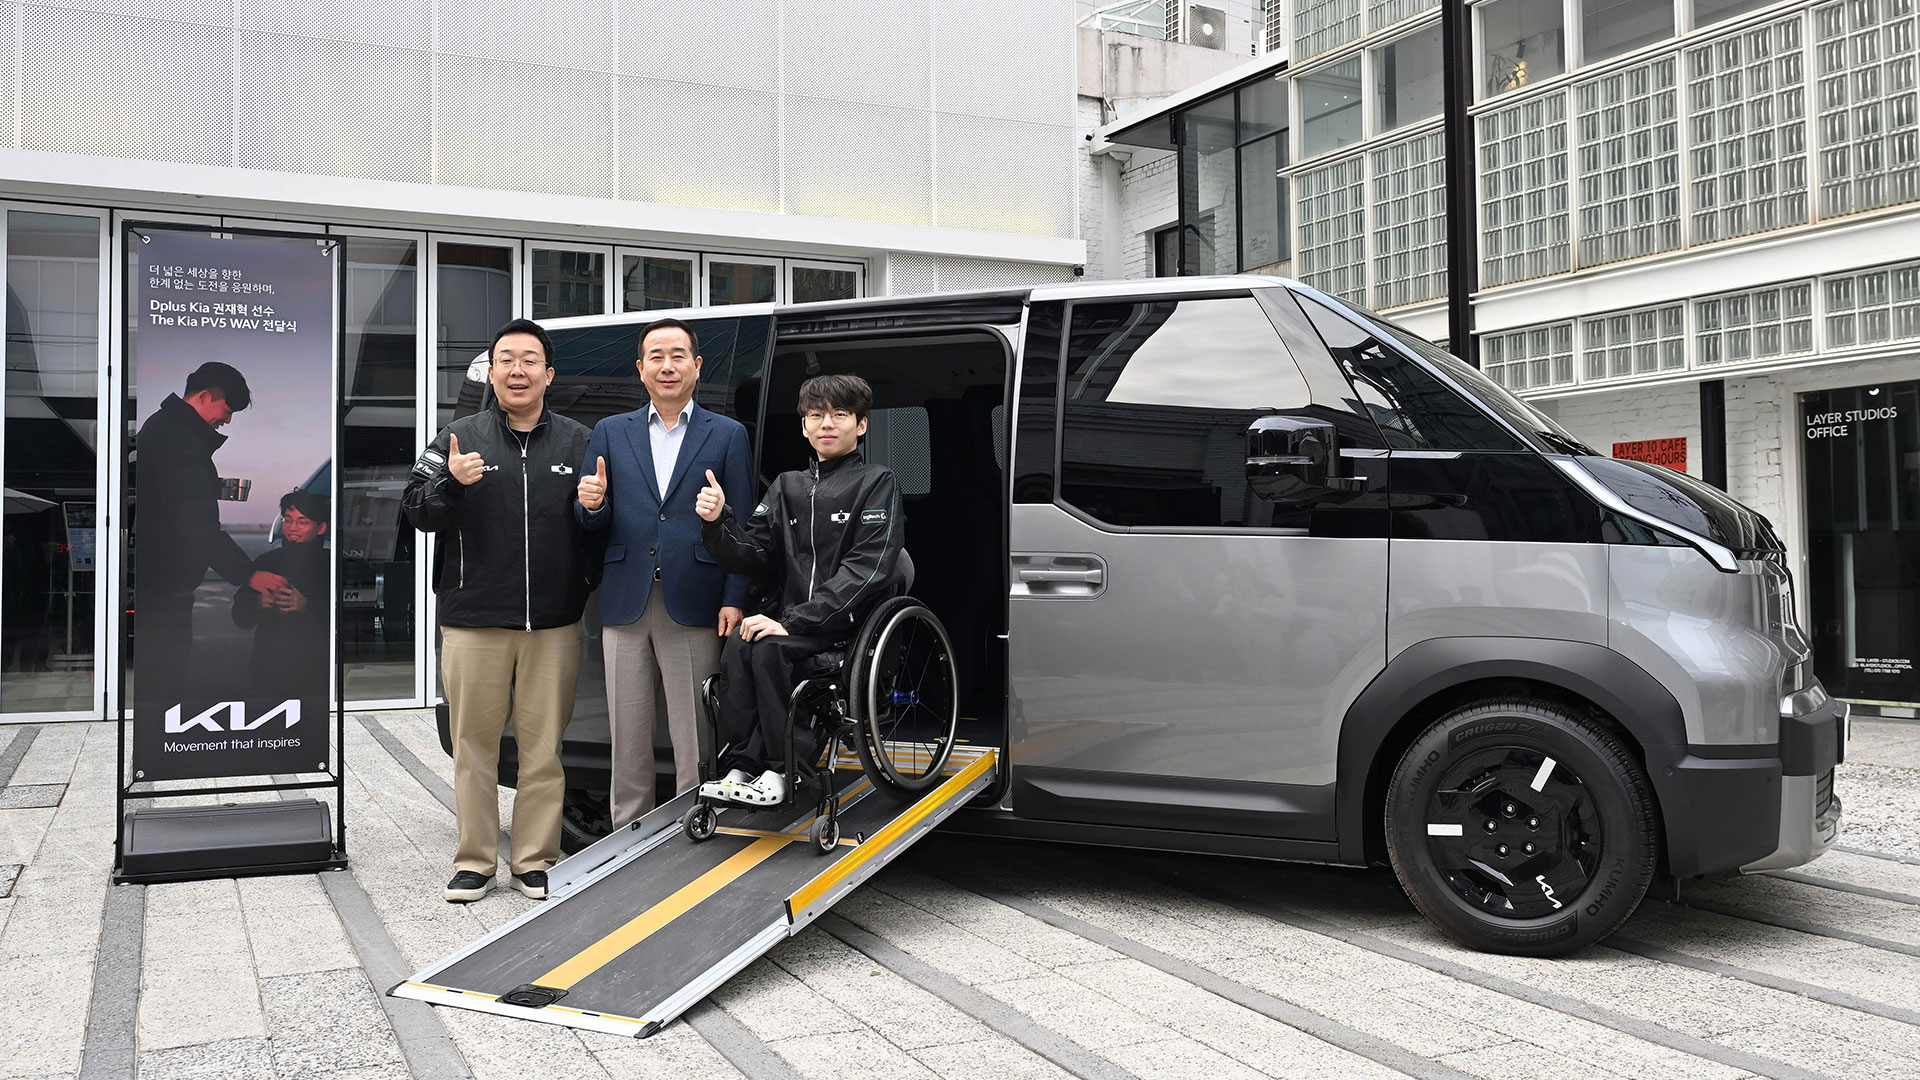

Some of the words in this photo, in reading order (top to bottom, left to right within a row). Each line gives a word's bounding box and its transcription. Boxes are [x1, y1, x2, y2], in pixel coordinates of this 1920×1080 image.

[149, 265, 159, 275] 더
[163, 265, 185, 277] 넓은
[187, 267, 218, 279] 세상을
[221, 269, 242, 280] 향한
[149, 277, 171, 289] 한계
[173, 278, 194, 290] 없는
[197, 280, 228, 293] 도전을
[232, 282, 275, 295] 응원하며,
[150, 299, 186, 313] Dplus
[189, 302, 210, 313] Kia
[213, 303, 248, 316] 권재혁
[251, 305, 275, 317] 선수
[150, 314, 174, 326] The
[177, 316, 198, 327] Kia
[201, 317, 227, 328] PV5
[230, 318, 260, 330] WAV
[262, 319, 297, 333] 전달식
[1806, 412, 1843, 426] LAYER
[1845, 406, 1898, 422] STUDIOS
[1806, 425, 1848, 439] OFFICE
[1612, 441, 1644, 456] LAYER
[1647, 440, 1658, 453] 10
[1660, 437, 1687, 452] CAFE
[1653, 451, 1687, 465] HOURS
[164, 698, 301, 734] KIA
[1455, 722, 1518, 743] CRUGEN
[164, 741, 227, 753] Movement
[230, 738, 254, 749] that
[257, 737, 301, 750] inspires
[1535, 874, 1563, 909] KIA
[1586, 858, 1625, 916] KUMHO
